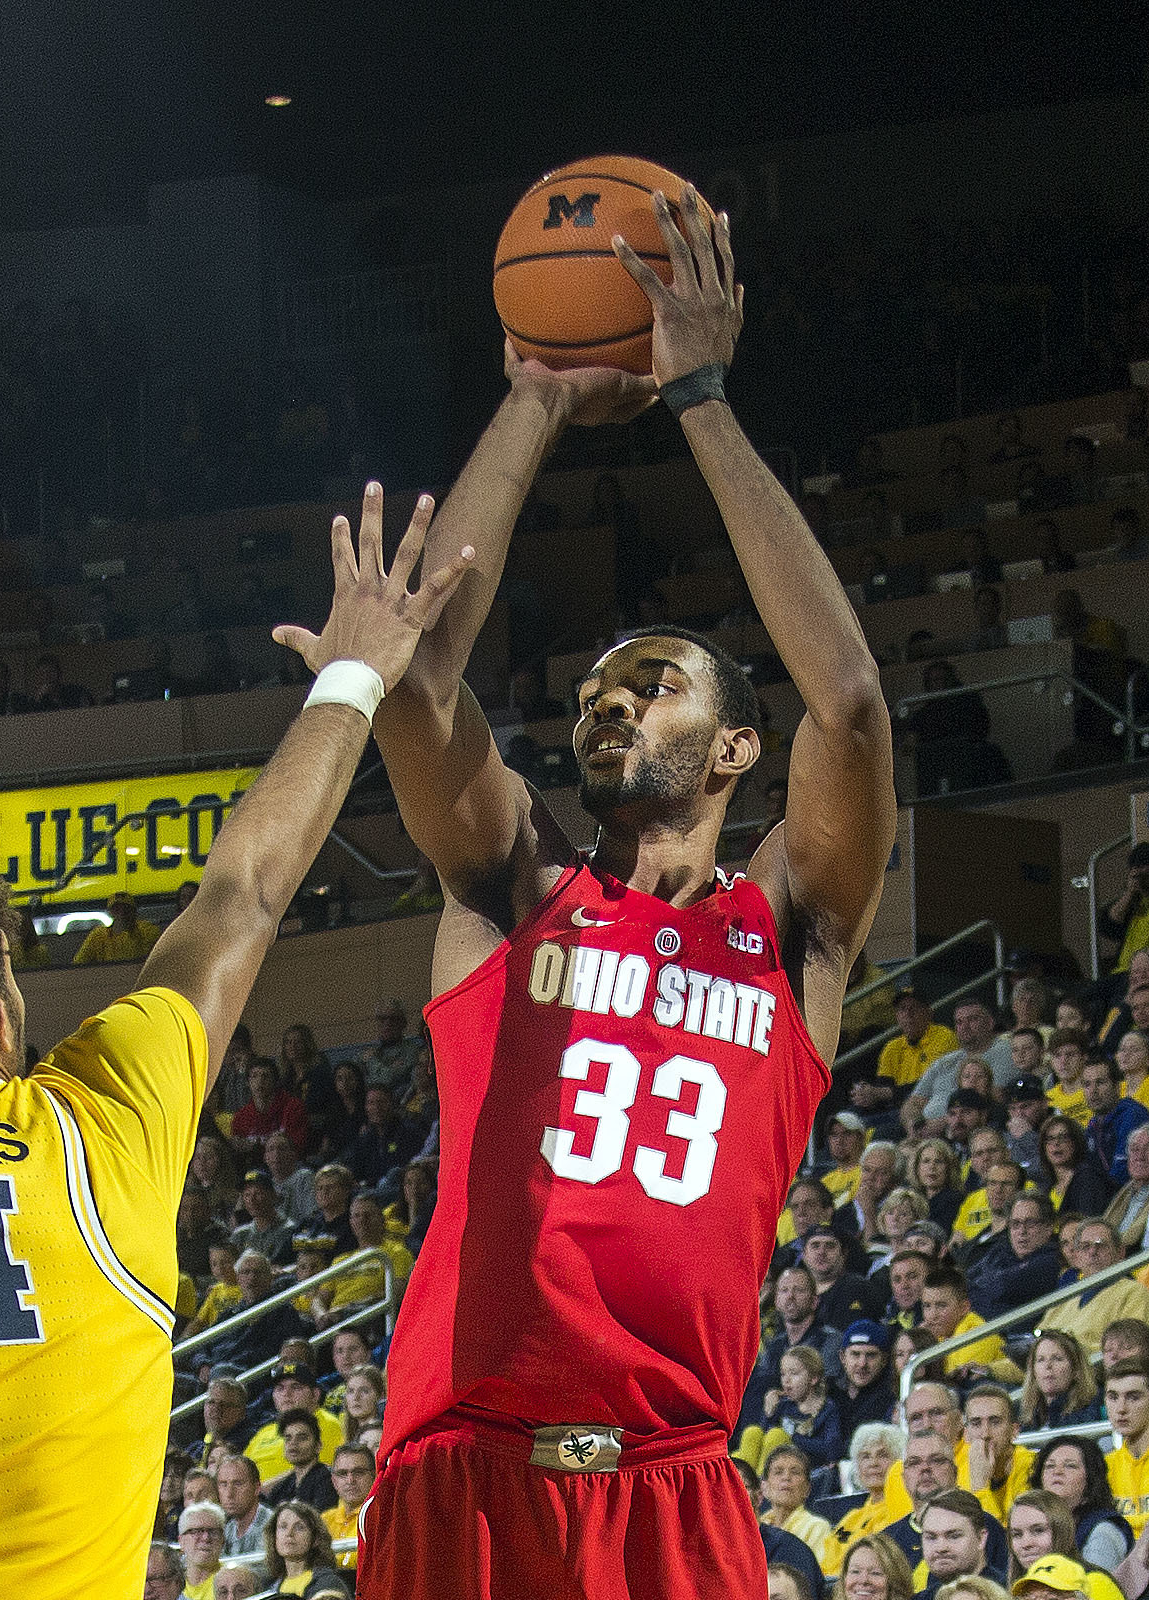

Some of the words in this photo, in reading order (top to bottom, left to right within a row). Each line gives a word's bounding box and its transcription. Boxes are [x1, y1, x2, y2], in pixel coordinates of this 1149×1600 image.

[543, 193, 601, 229] M
[528, 940, 650, 1018] OHIO
[653, 963, 776, 1057] STATE
[540, 1037, 727, 1207] 33
